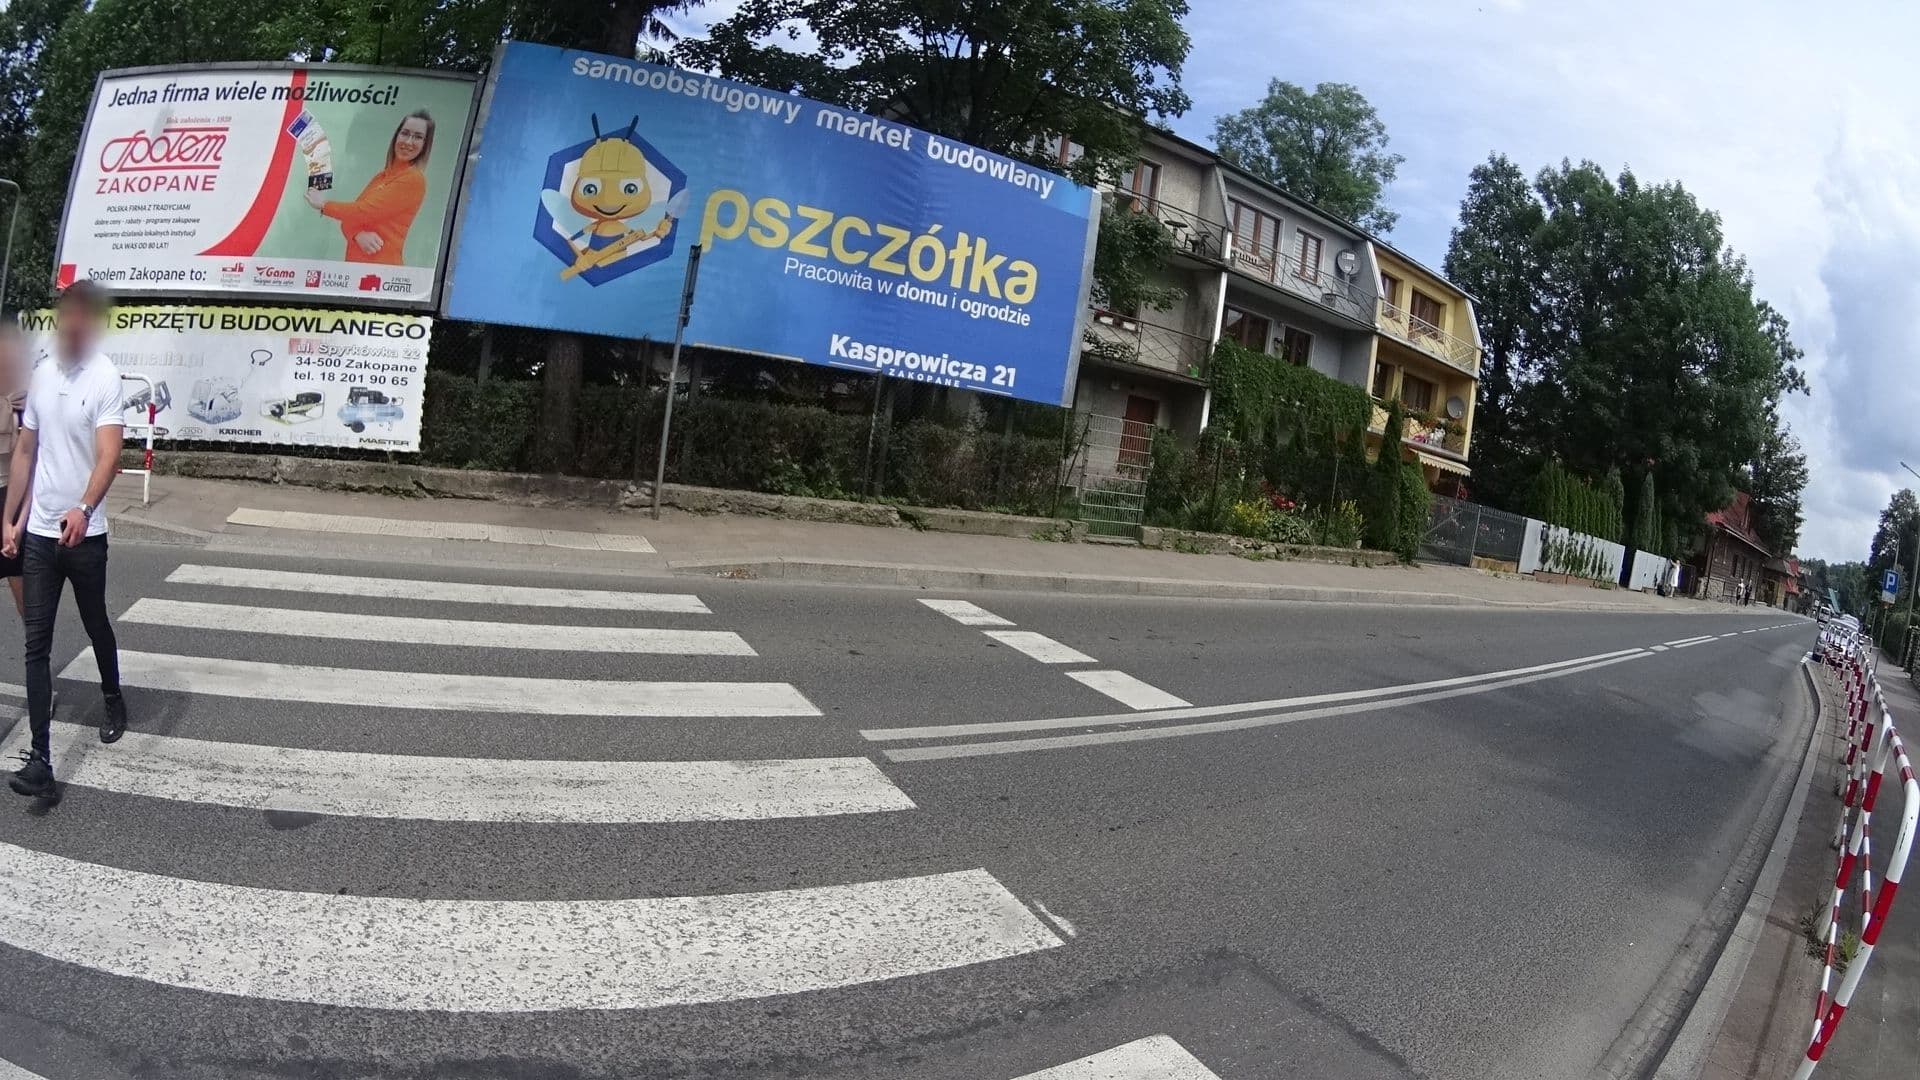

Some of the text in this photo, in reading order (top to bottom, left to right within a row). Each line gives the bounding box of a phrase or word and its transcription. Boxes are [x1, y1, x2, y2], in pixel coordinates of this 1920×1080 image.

[108, 81, 399, 107] Jedna firma wiele możliwości!
[572, 57, 1055, 200] samoobsługowy market budowlany
[96, 175, 217, 195] ZAKOPANE
[106, 205, 128, 213] POLSKA
[129, 204, 146, 212] FIRMA
[152, 203, 191, 211] TRADYCJAMI
[700, 188, 1038, 305] pszczółka
[130, 266, 186, 283] Zakopane
[190, 267, 207, 281] to:
[266, 267, 295, 278] Gama
[784, 257, 1031, 327] Pracowita w domu i ogrodzie
[115, 312, 215, 333] SPRZĘTU
[220, 313, 426, 340] BUDOWLANEGO
[297, 342, 314, 354] ul.
[318, 343, 398, 357] Spyrkówka
[295, 356, 417, 373] 34-500 Zakopane
[829, 333, 1017, 388] Kasprowicza 21
[294, 371, 408, 386] tel. 18 201 90 65
[888, 368, 961, 388] ZAKOPANE
[359, 437, 410, 447] MASTER
[1886, 573, 1895, 589] P
